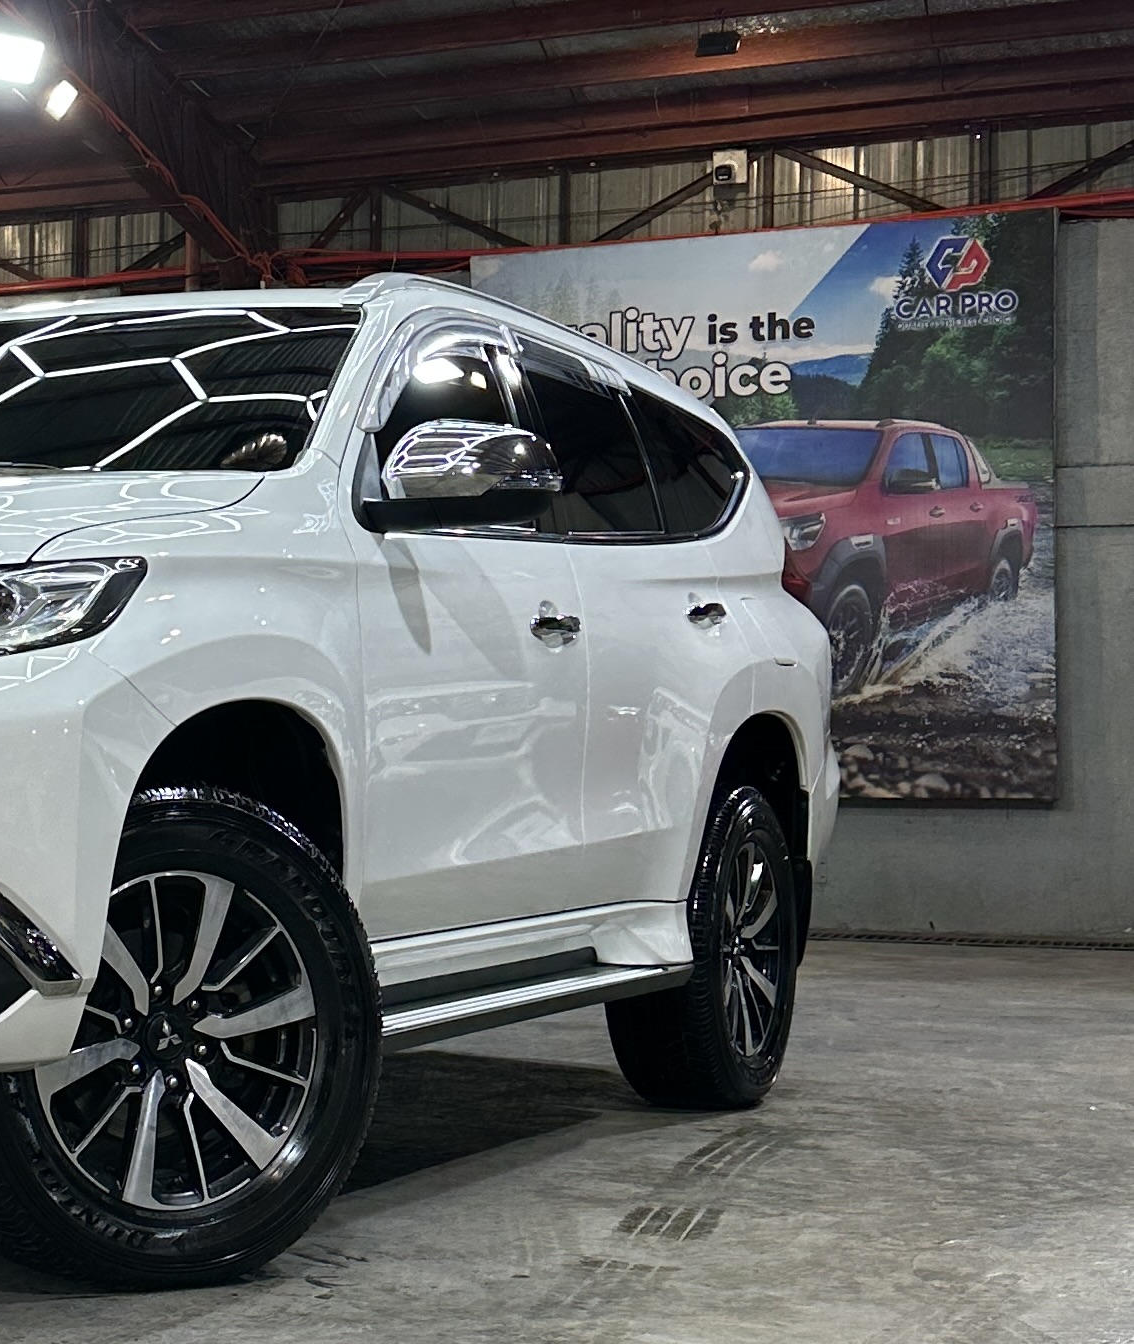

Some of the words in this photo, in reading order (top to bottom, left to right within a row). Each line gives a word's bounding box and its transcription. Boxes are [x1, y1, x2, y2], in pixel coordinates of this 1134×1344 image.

[895, 292, 952, 321] CAR
[959, 289, 1018, 315] PRO
[566, 306, 695, 361] ality
[708, 314, 738, 345] is
[749, 312, 815, 341] the
